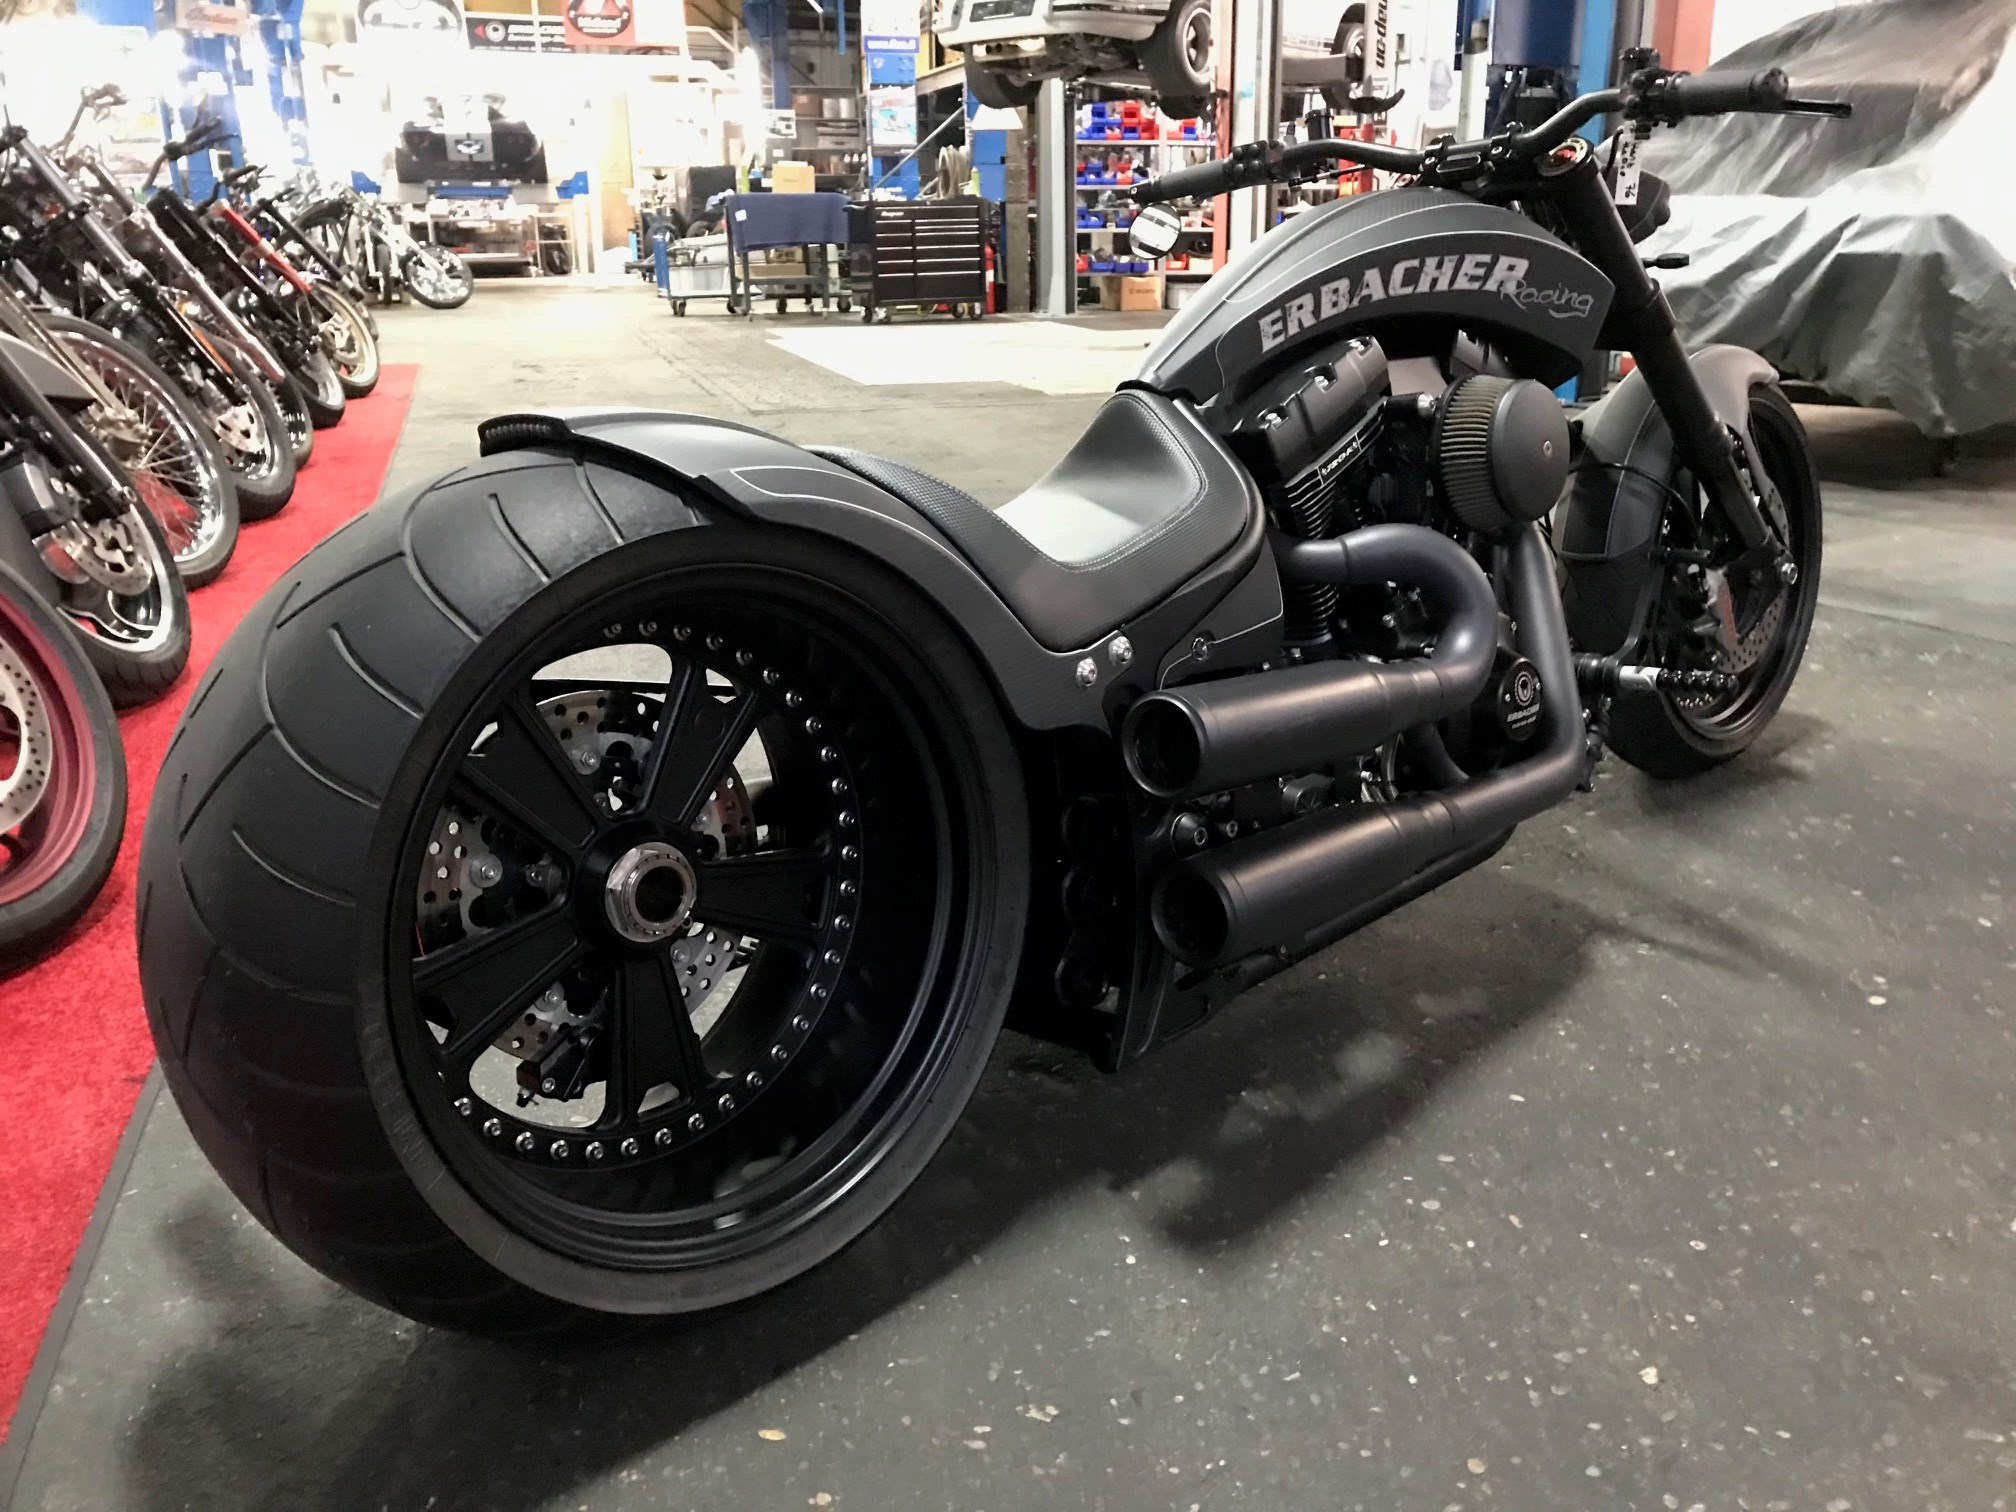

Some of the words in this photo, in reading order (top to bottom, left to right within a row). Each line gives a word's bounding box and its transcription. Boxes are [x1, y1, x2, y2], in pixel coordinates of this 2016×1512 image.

[1374, 0, 1387, 69] nap-on
[1258, 252, 1529, 353] ERBACHER
[1499, 278, 1594, 318] Racing
